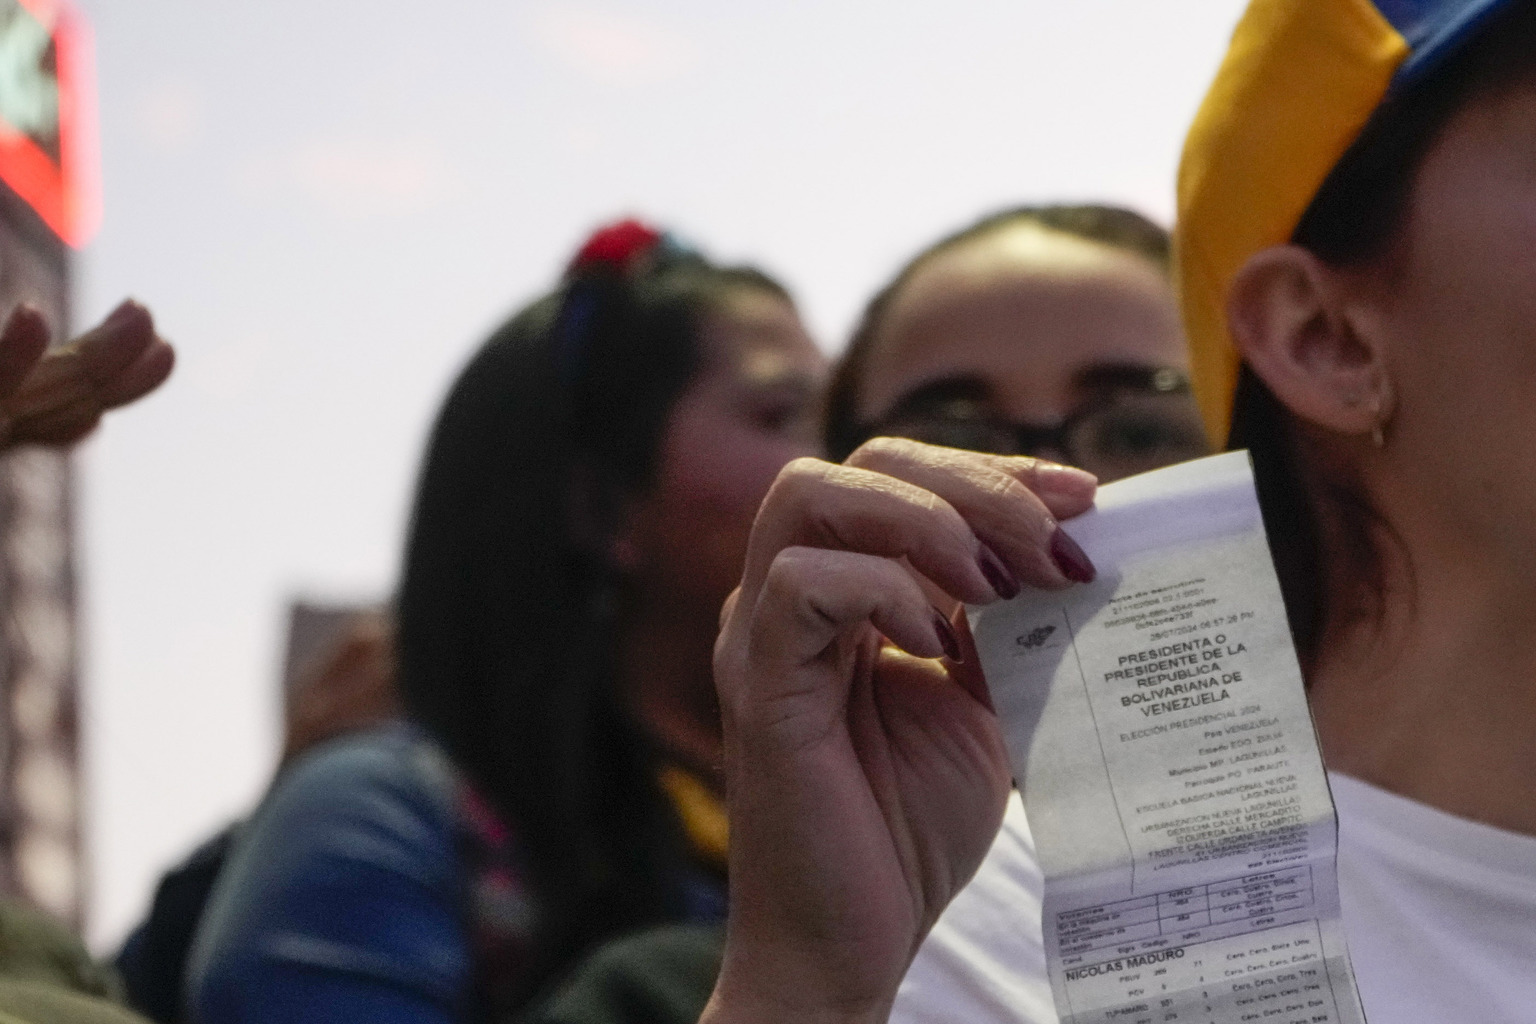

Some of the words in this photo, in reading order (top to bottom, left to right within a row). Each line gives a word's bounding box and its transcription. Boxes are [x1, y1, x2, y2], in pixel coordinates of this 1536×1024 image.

[1104, 654, 1198, 682] PRESIDENTE
[1202, 648, 1222, 660] DE
[1227, 643, 1247, 656] LA
[1118, 638, 1212, 666] PRESIDENTA
[1215, 634, 1226, 644] O
[1121, 677, 1219, 706] BOLIVARIANA
[1222, 672, 1242, 684] DE
[1137, 662, 1221, 688] REPUBLICA
[1140, 689, 1230, 716] VENEZUELA
[1066, 960, 1123, 982] NICOLAS
[1127, 949, 1184, 969] MADURO
